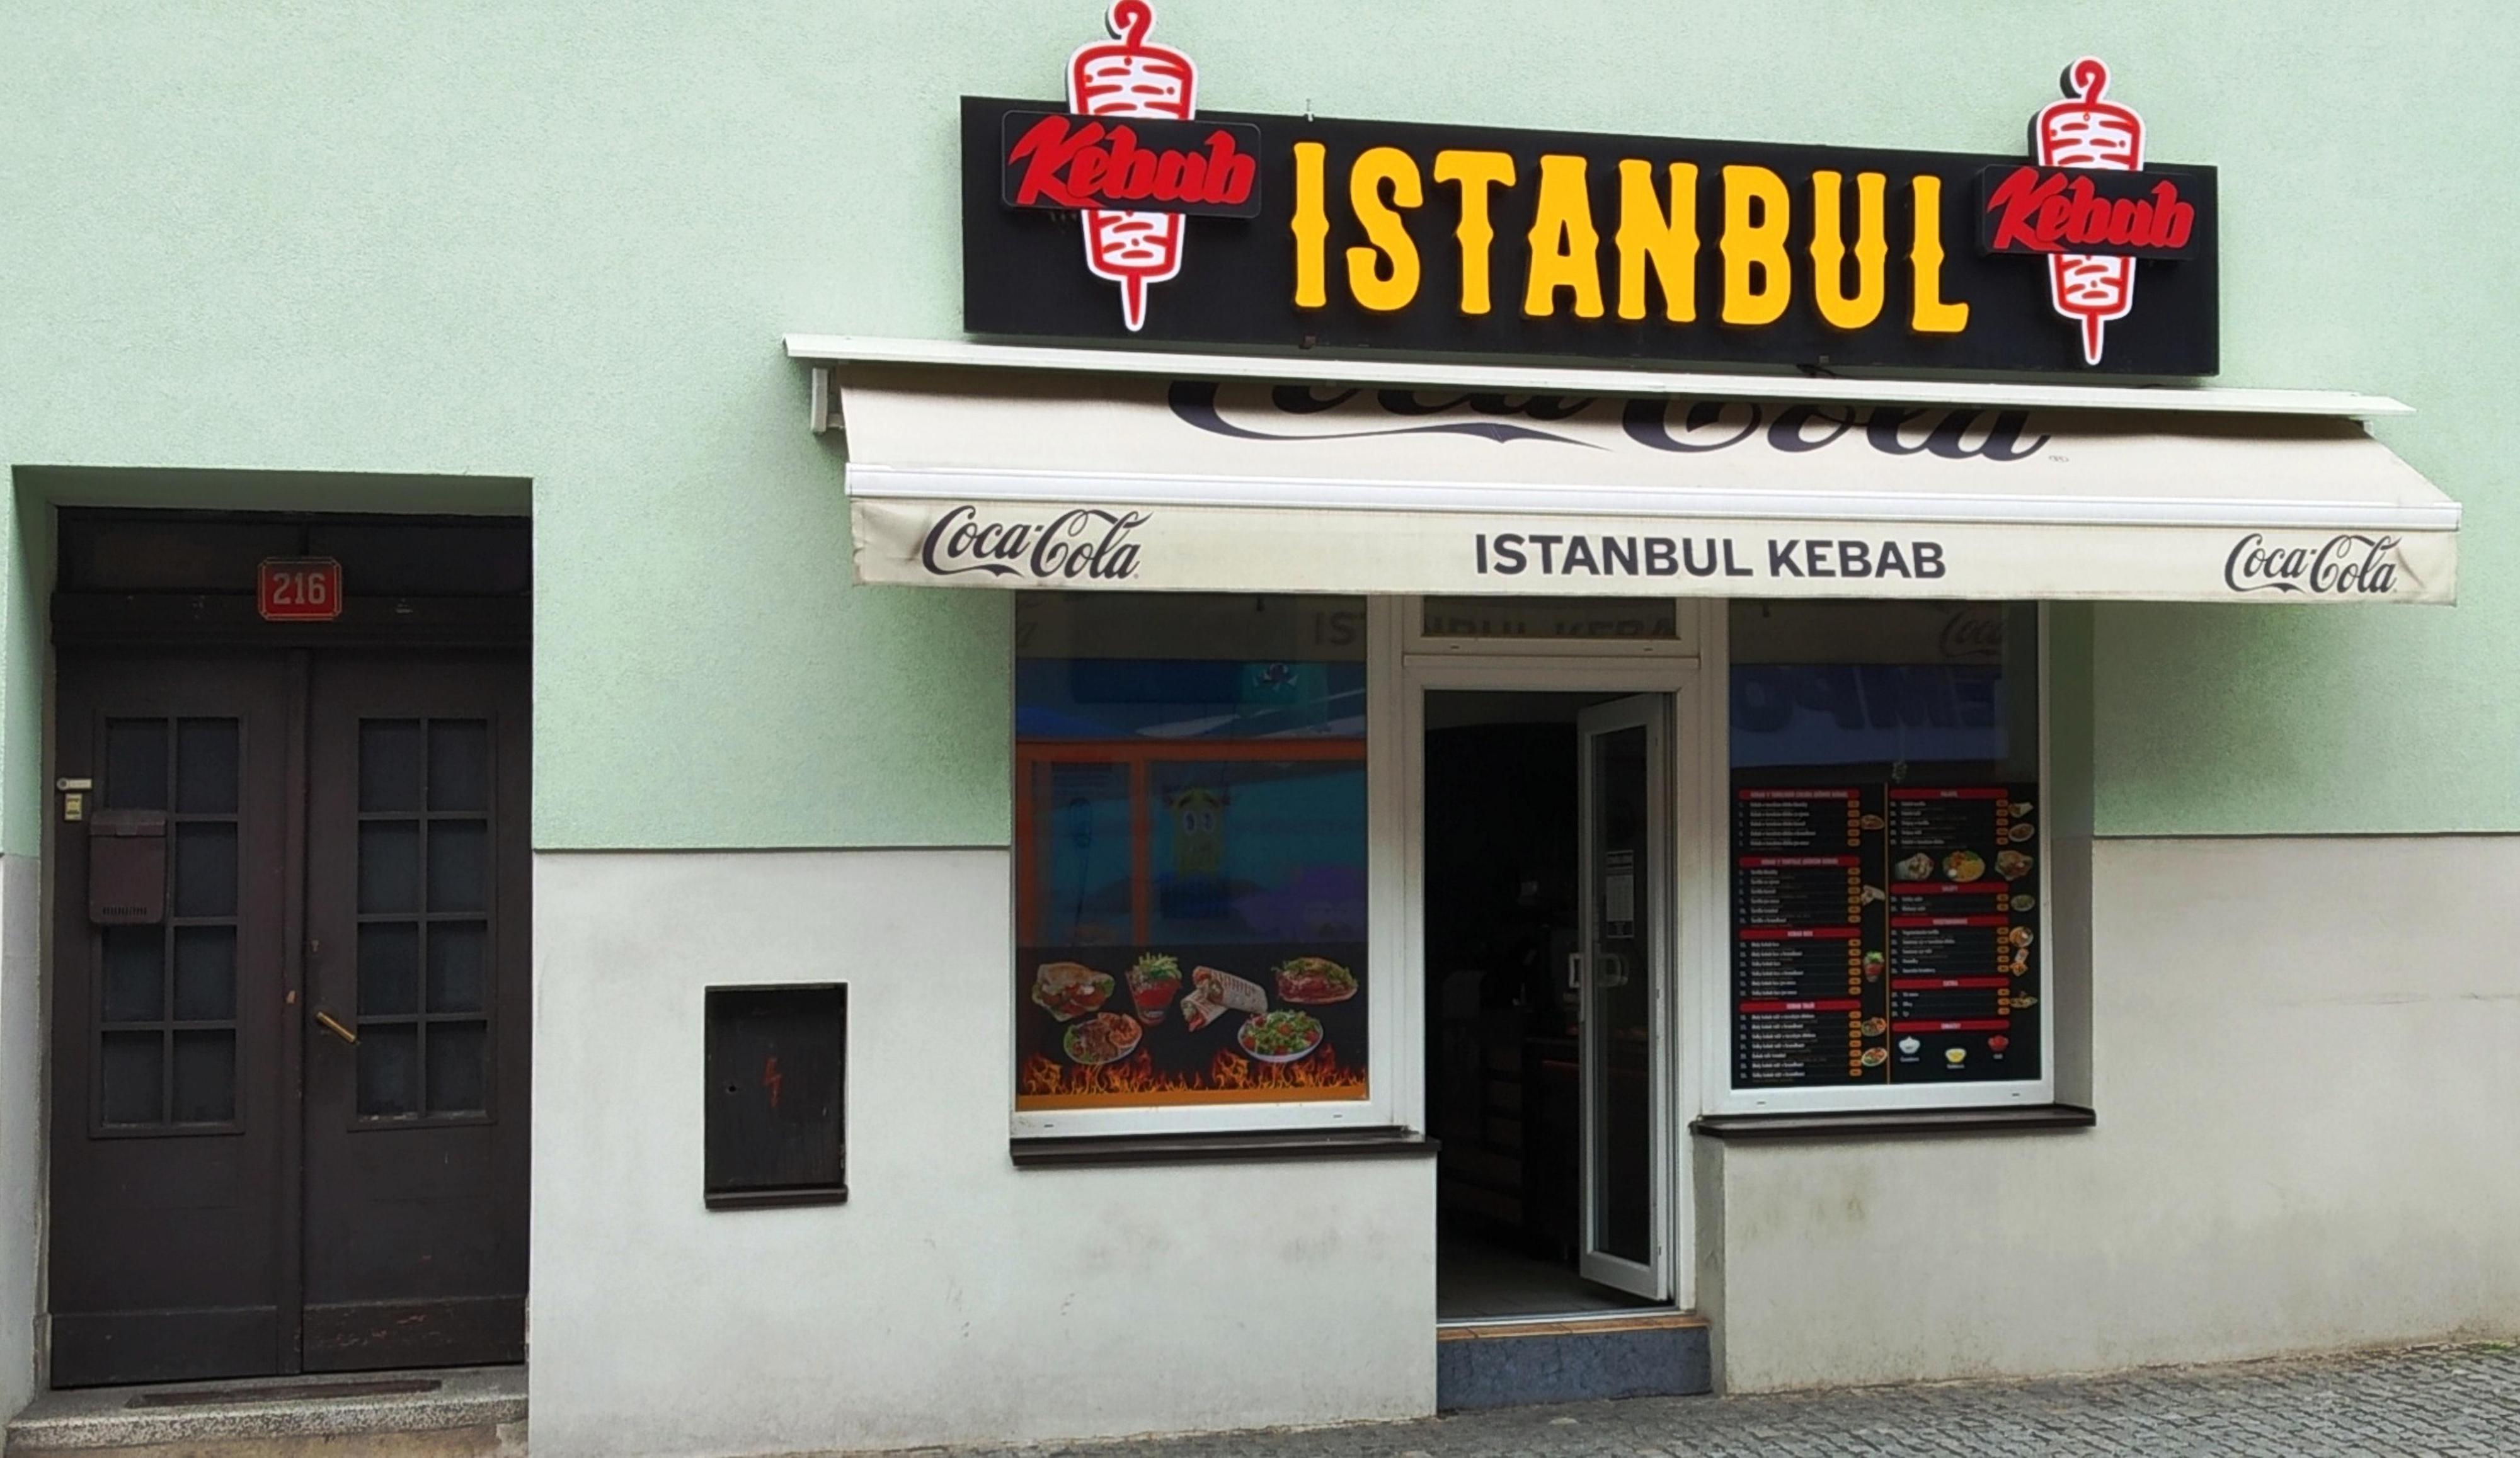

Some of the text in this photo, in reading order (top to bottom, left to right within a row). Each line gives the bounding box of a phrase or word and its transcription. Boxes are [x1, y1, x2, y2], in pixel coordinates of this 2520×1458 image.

[1009, 115, 1256, 208] Kebab
[1290, 142, 1969, 333] ISTANBUL
[1987, 166, 2194, 253] Kebab
[922, 505, 1154, 579] Coca-Cola
[1475, 533, 1946, 579] ISTANBUL KEBAB
[2225, 533, 2402, 593] Coca-Cola
[273, 572, 326, 605] 216
